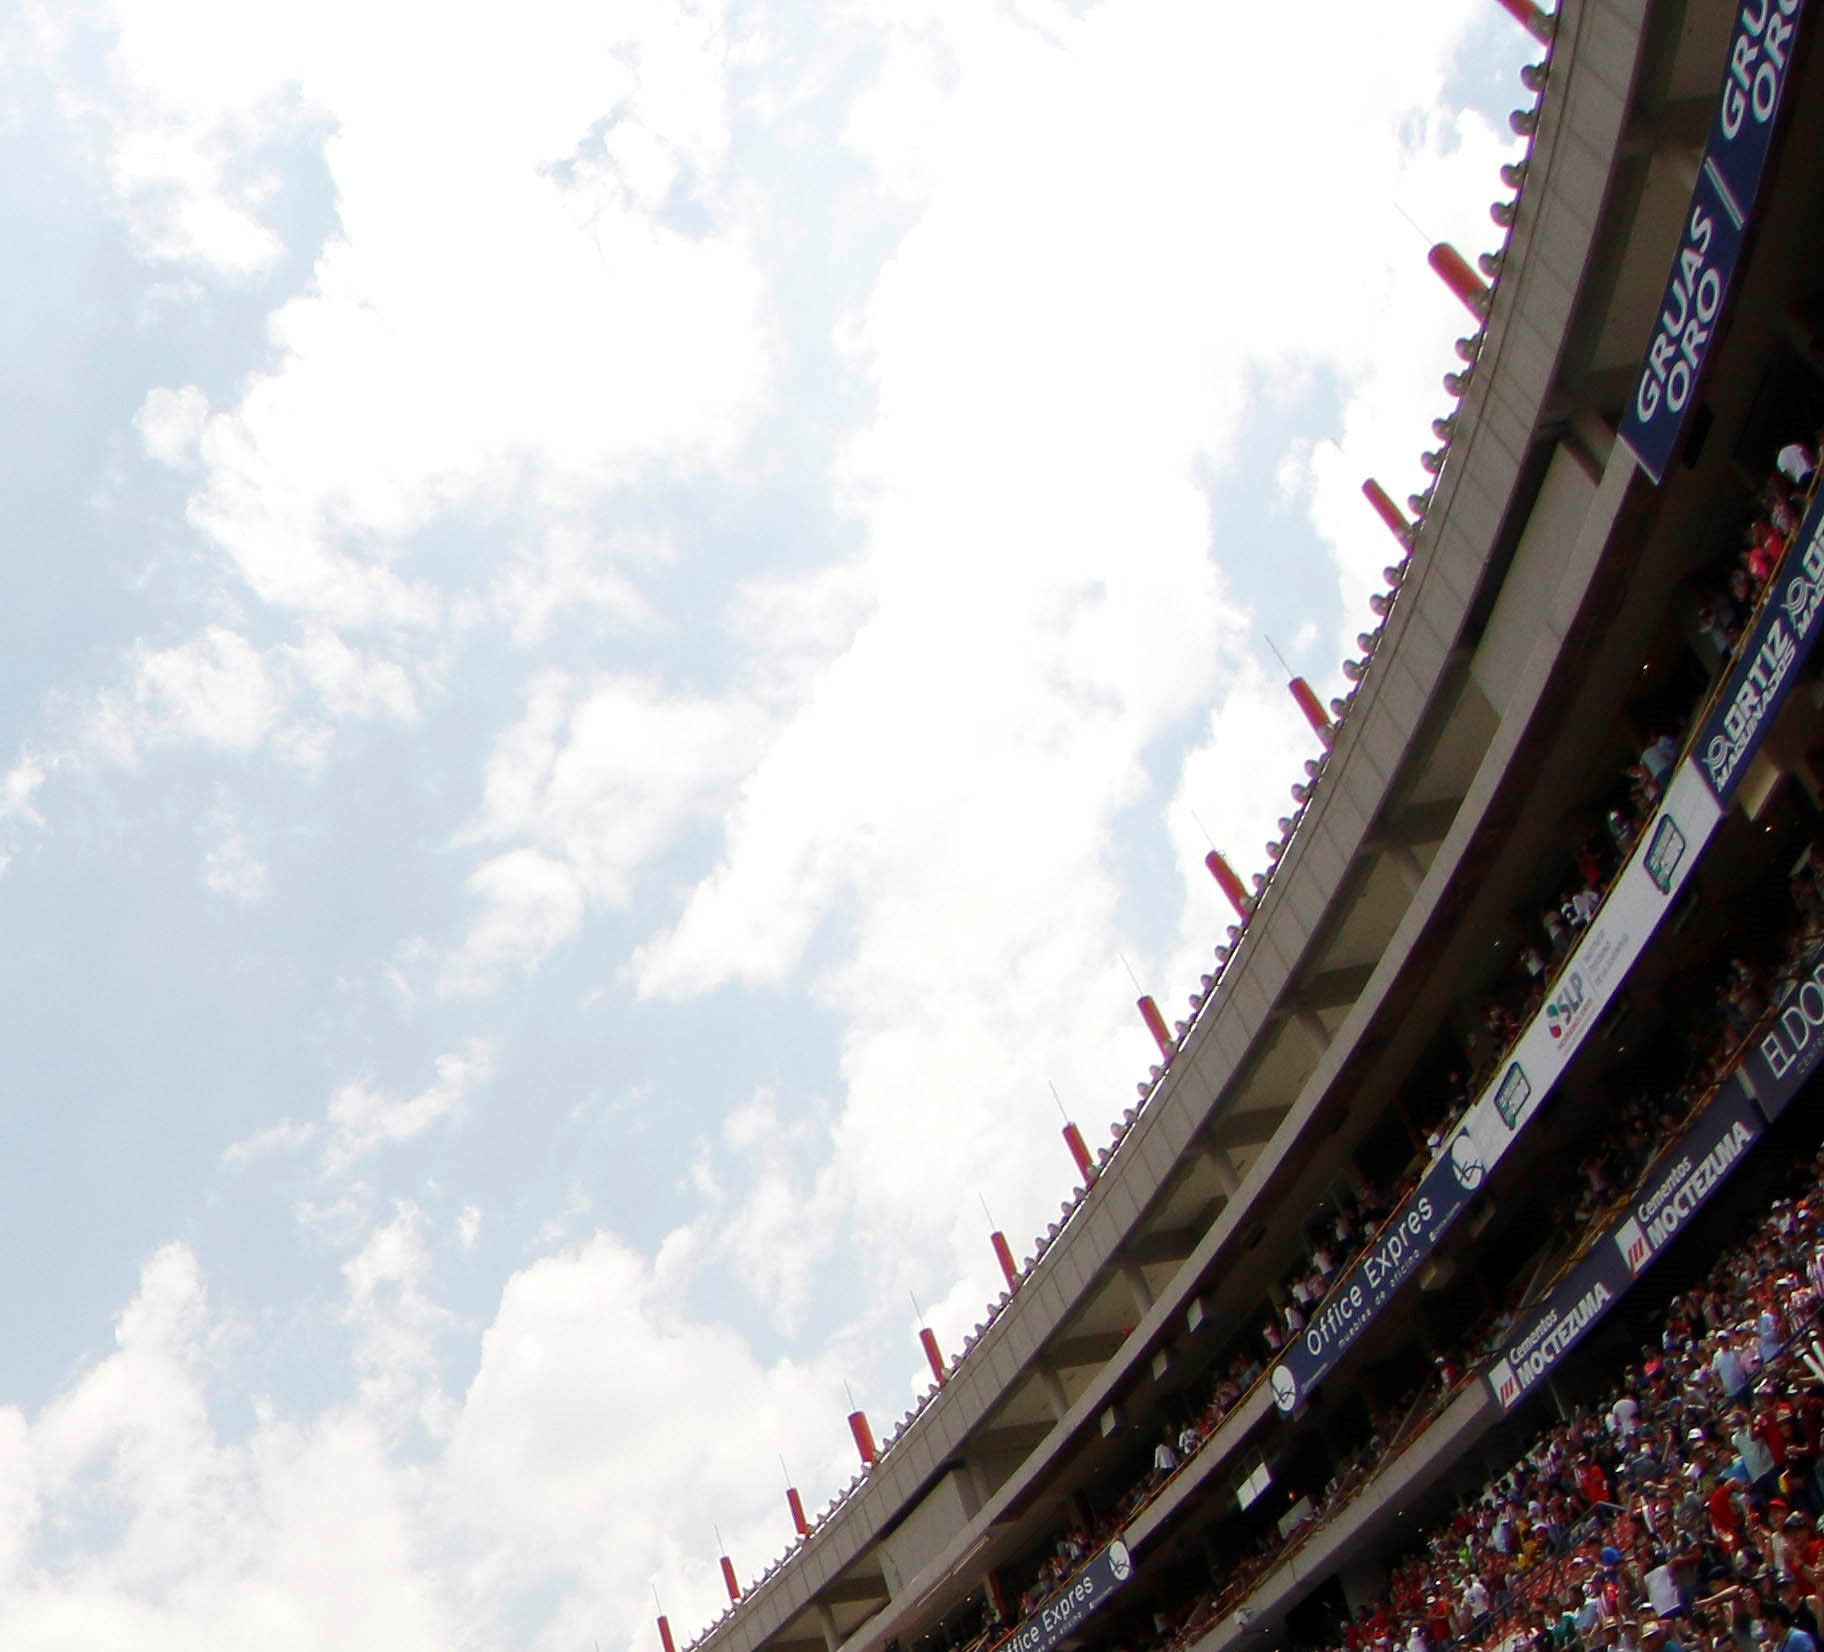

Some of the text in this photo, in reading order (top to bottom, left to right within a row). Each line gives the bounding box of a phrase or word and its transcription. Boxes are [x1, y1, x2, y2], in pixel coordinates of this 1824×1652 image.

[1637, 205, 1714, 424] GRUAS
[1667, 267, 1722, 413] ORO
[1723, 616, 1790, 739] ORTIZ
[1637, 1156, 1693, 1223] Cementos
[1646, 1120, 1754, 1250] MOCTEZUMA
[1306, 1283, 1363, 1357] Office
[1363, 1197, 1434, 1289] Expres
[1509, 1310, 1559, 1366] Cementos
[1516, 1281, 1613, 1389] MOCTEZUMA
[1041, 1576, 1094, 1633] Expres
